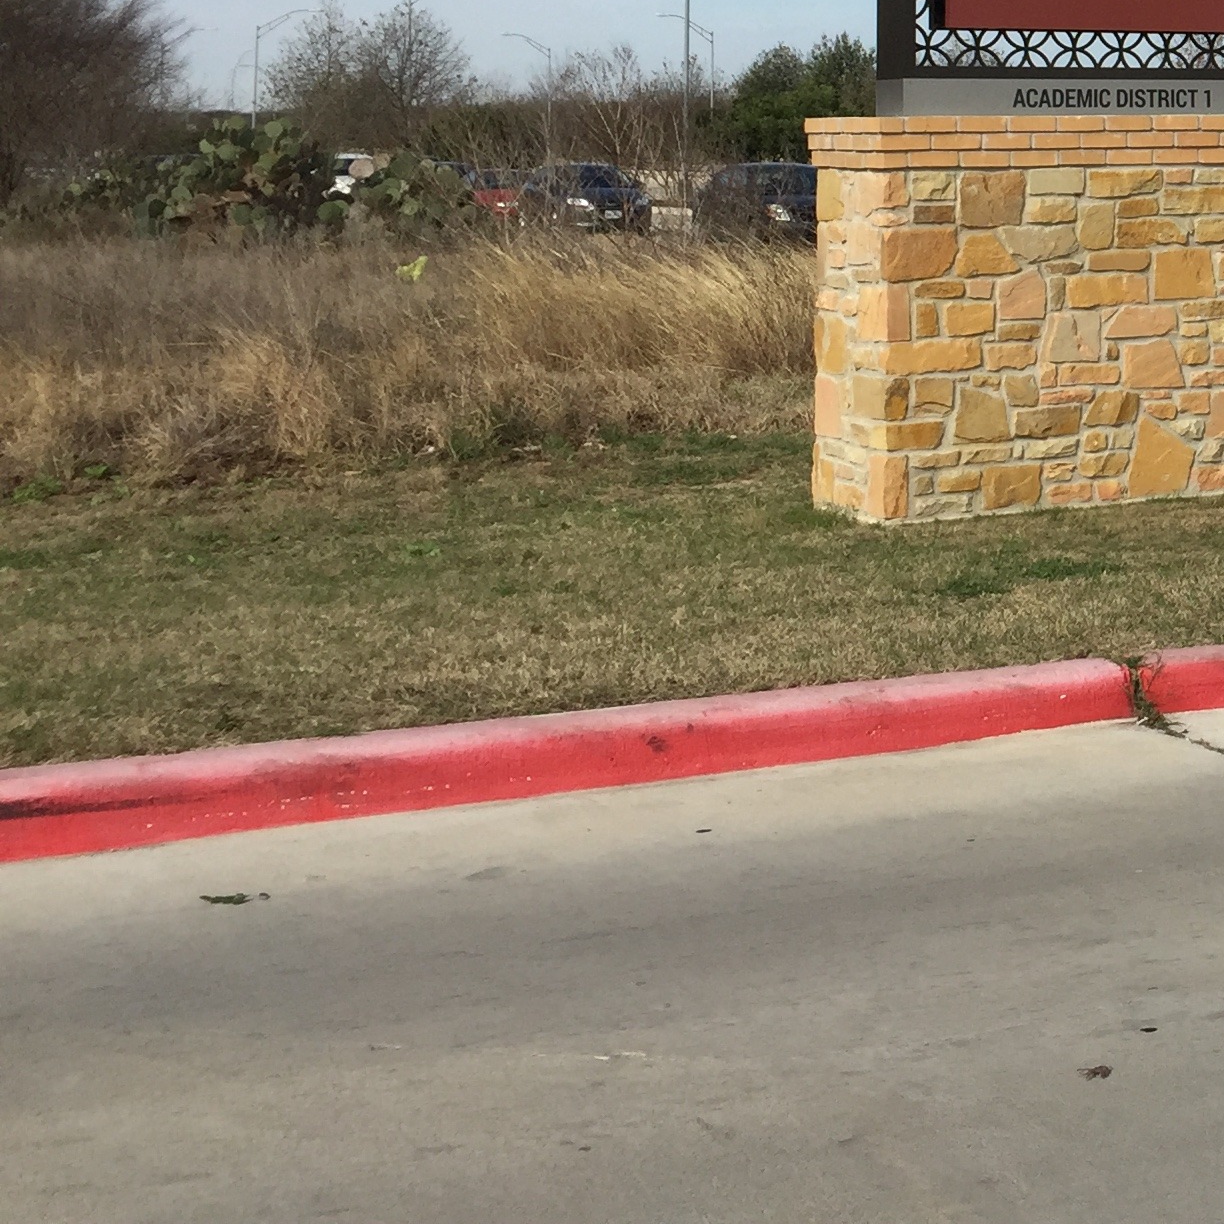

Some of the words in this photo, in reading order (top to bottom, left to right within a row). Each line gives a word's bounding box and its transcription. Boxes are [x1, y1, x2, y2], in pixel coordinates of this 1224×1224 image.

[1012, 88, 1111, 108] ACADEMIC
[1116, 88, 1199, 108] DISTRICT
[1203, 89, 1212, 108] 1
